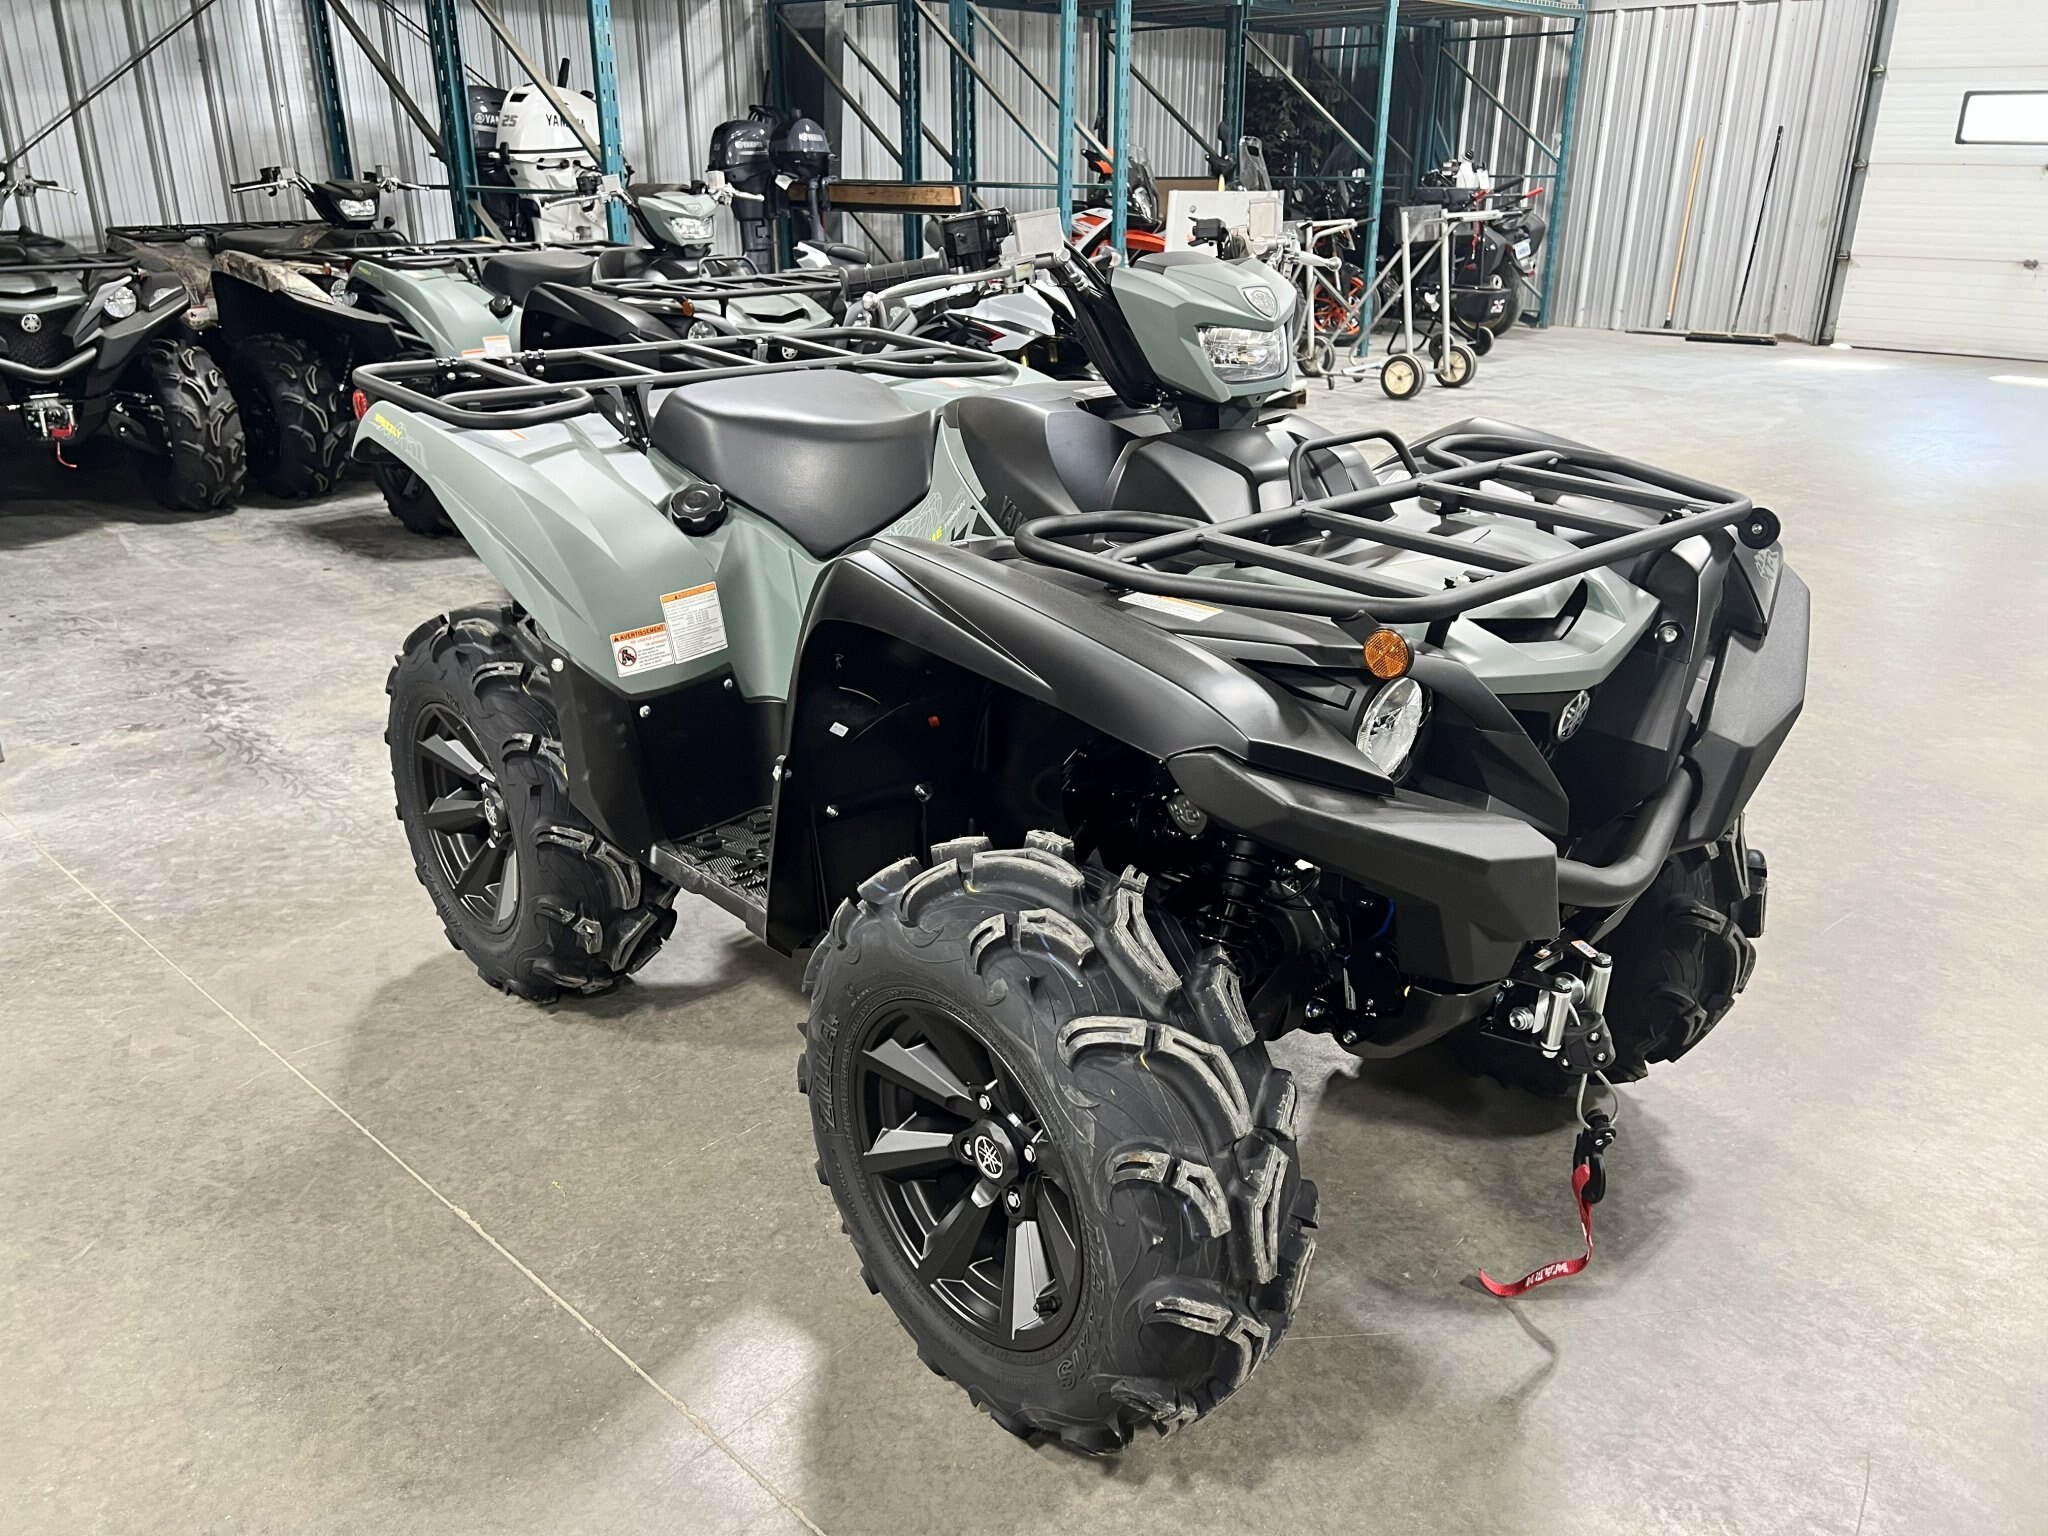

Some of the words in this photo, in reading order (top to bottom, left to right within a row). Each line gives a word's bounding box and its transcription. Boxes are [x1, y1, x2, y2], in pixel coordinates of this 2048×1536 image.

[501, 114, 519, 128] 25
[620, 624, 665, 641] AVERTISSEMENT
[1525, 1261, 1569, 1288] WARN
